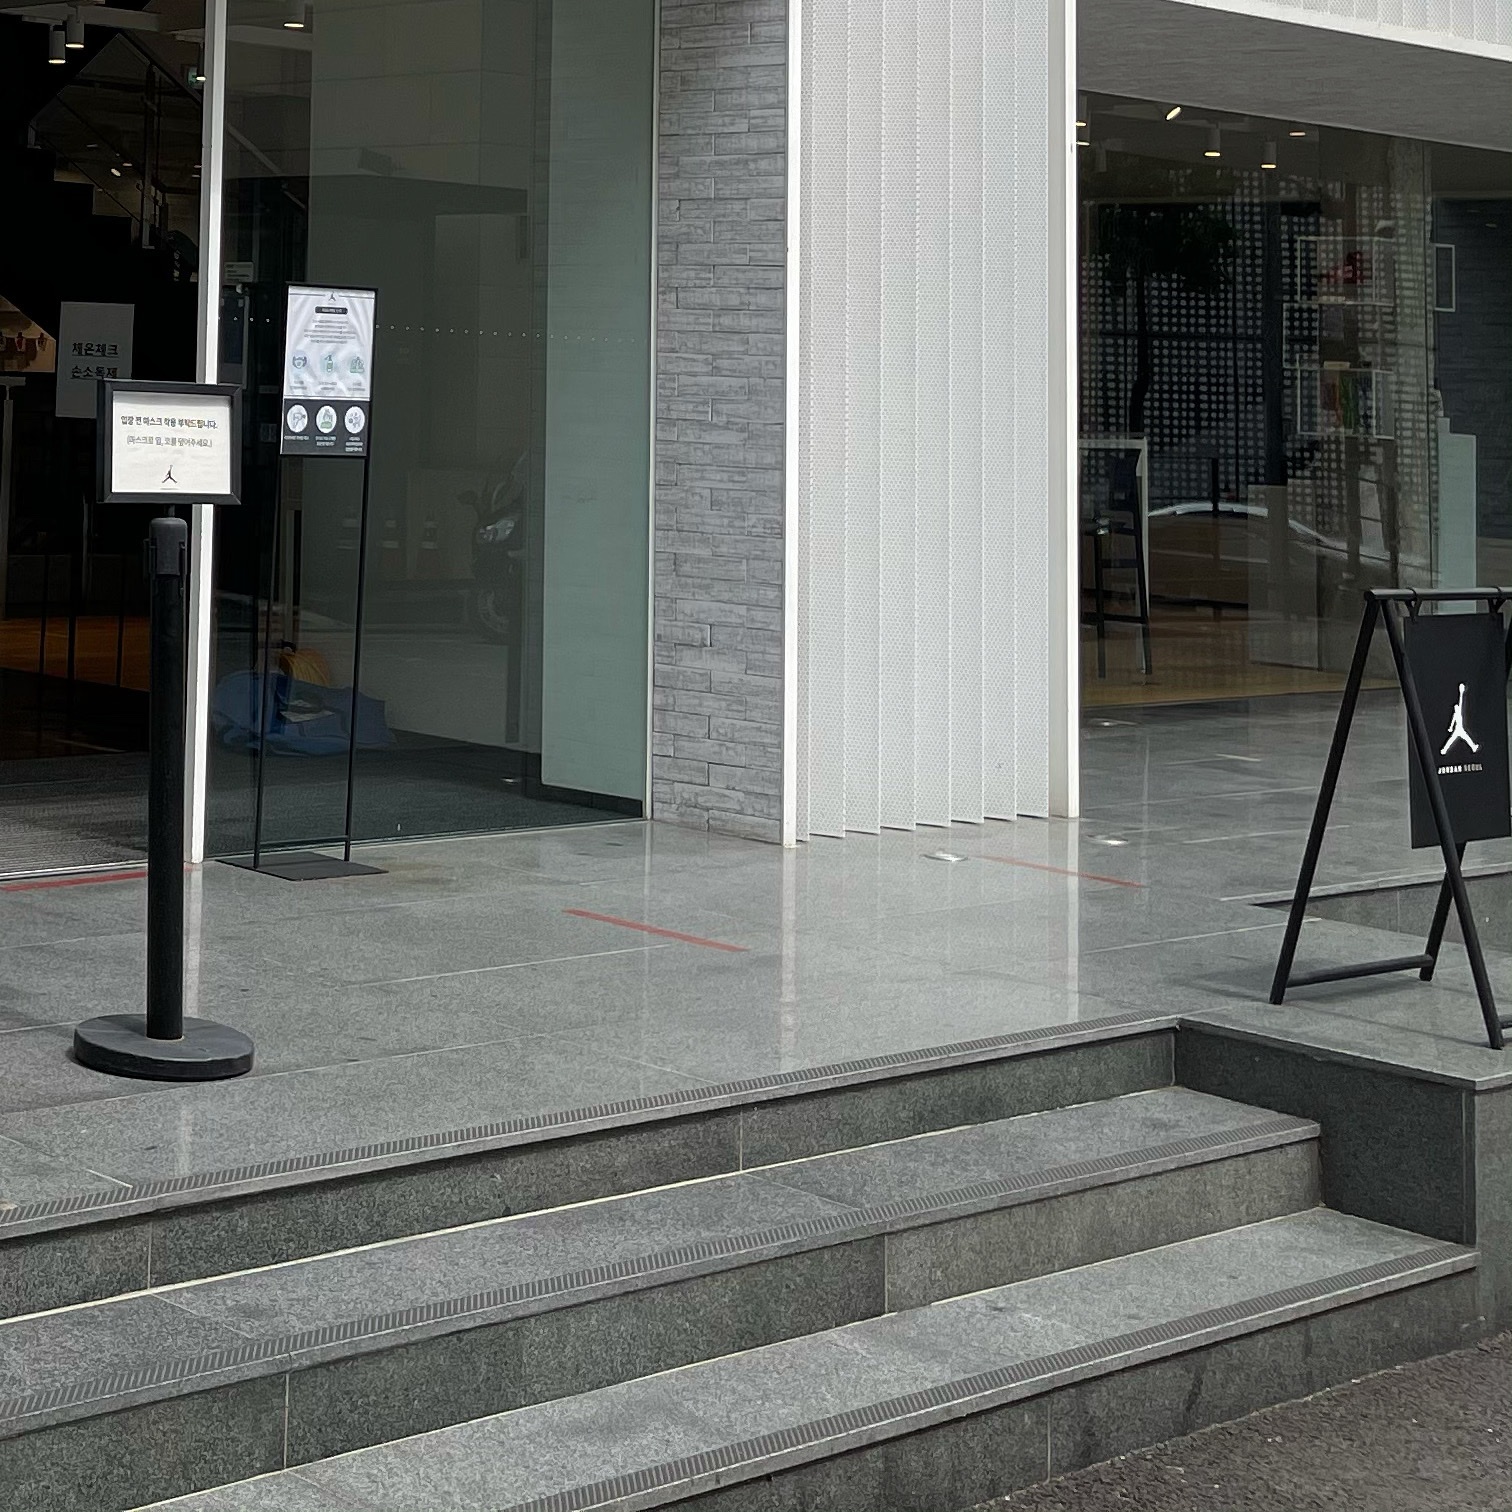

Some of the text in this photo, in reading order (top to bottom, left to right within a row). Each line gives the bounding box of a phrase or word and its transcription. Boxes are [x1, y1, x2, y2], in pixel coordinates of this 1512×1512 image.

[72, 342, 118, 356] 체온체크
[71, 365, 118, 379] 손소독제
[143, 416, 162, 426] 마스크
